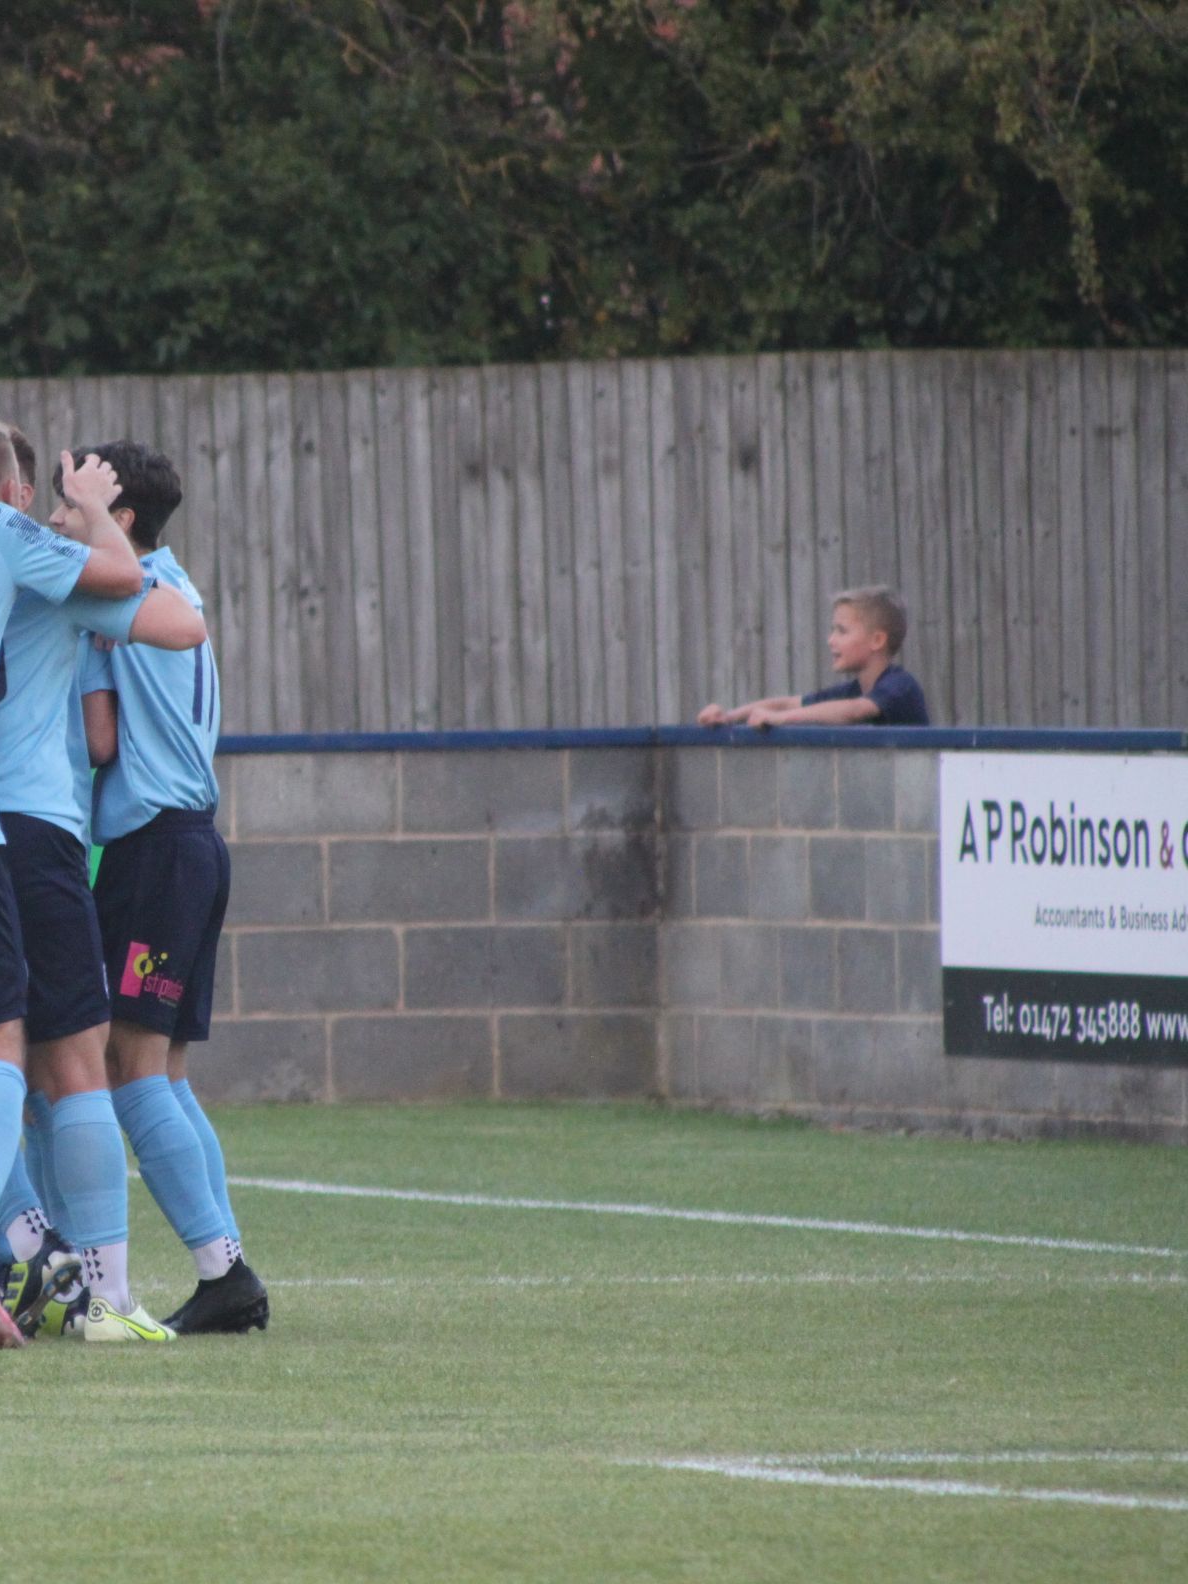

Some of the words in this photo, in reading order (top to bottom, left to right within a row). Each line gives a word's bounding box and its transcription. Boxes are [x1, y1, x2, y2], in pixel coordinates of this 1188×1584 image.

[1010, 800, 1150, 869] Robinson
[1160, 820, 1174, 869] &
[1034, 903, 1106, 929] Accountants
[1109, 904, 1116, 929] &
[1120, 903, 1169, 931] Business
[983, 992, 1014, 1034] Tel:
[1019, 1003, 1071, 1041] 01472
[1076, 1001, 1141, 1045] 345888
